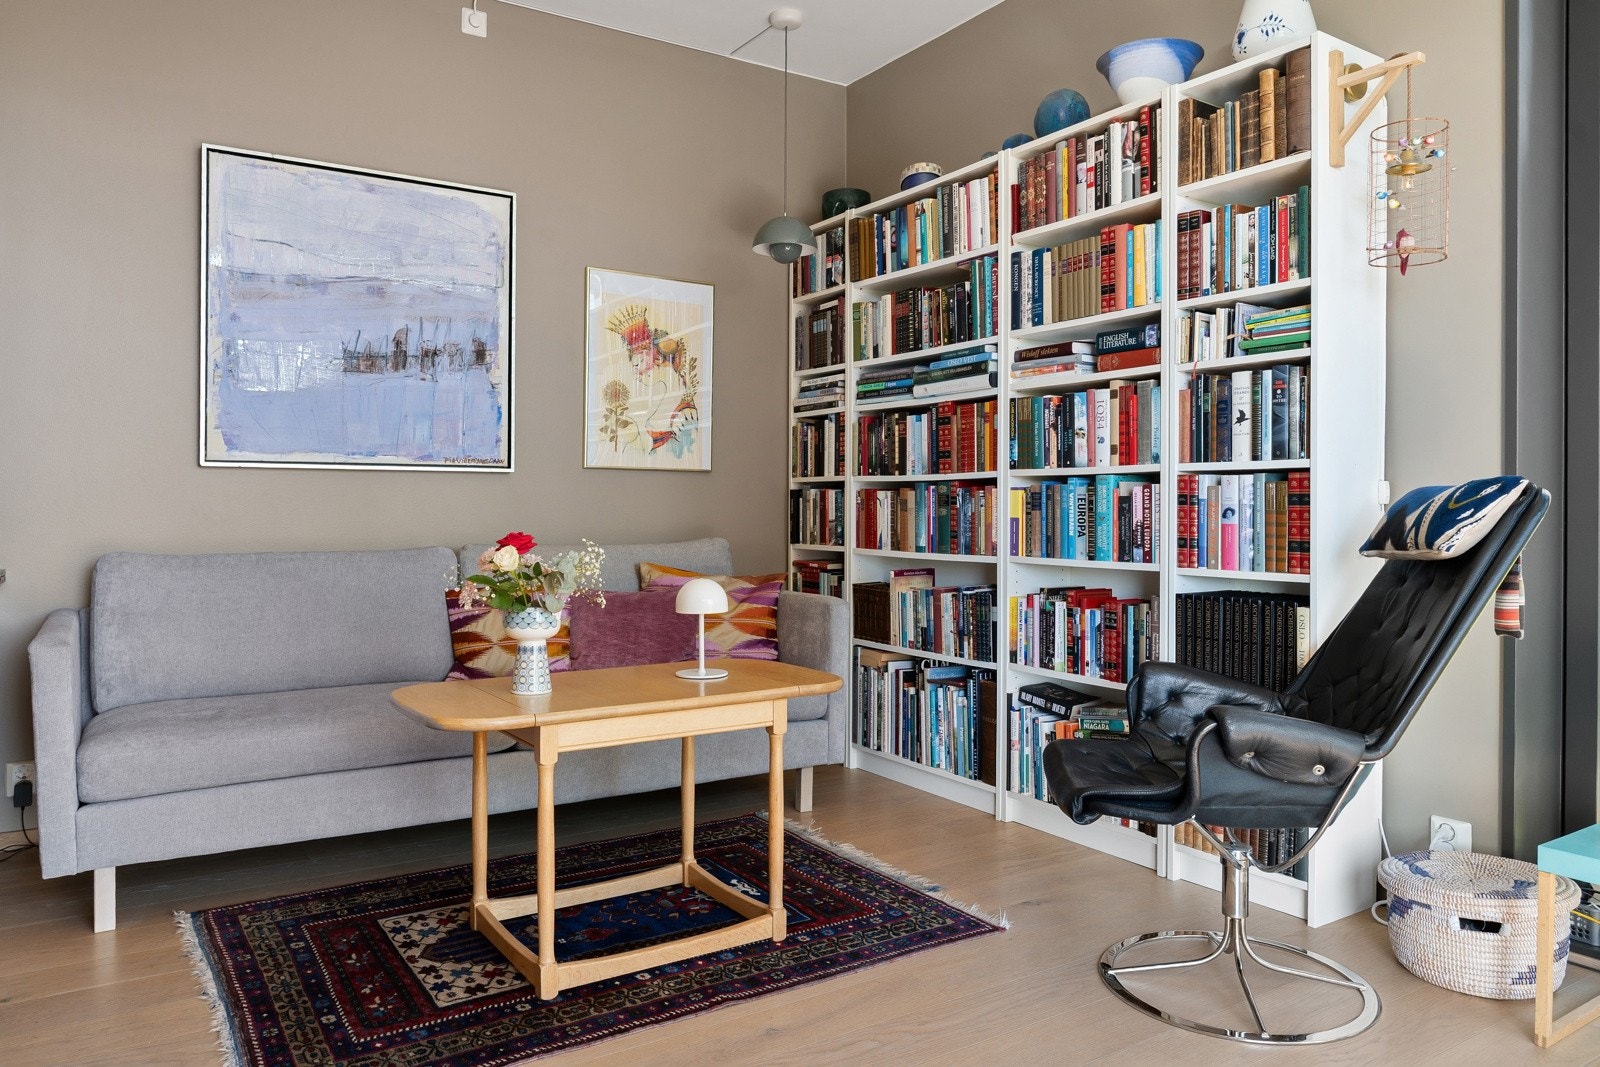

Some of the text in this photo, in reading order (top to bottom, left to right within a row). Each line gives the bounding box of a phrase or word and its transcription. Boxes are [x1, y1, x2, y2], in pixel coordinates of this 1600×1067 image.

[1104, 332, 1129, 343] ENGLISH
[1104, 338, 1136, 349] LITERATURE
[1096, 399, 1105, 430] 1Q84
[1077, 498, 1086, 538] EUROPA
